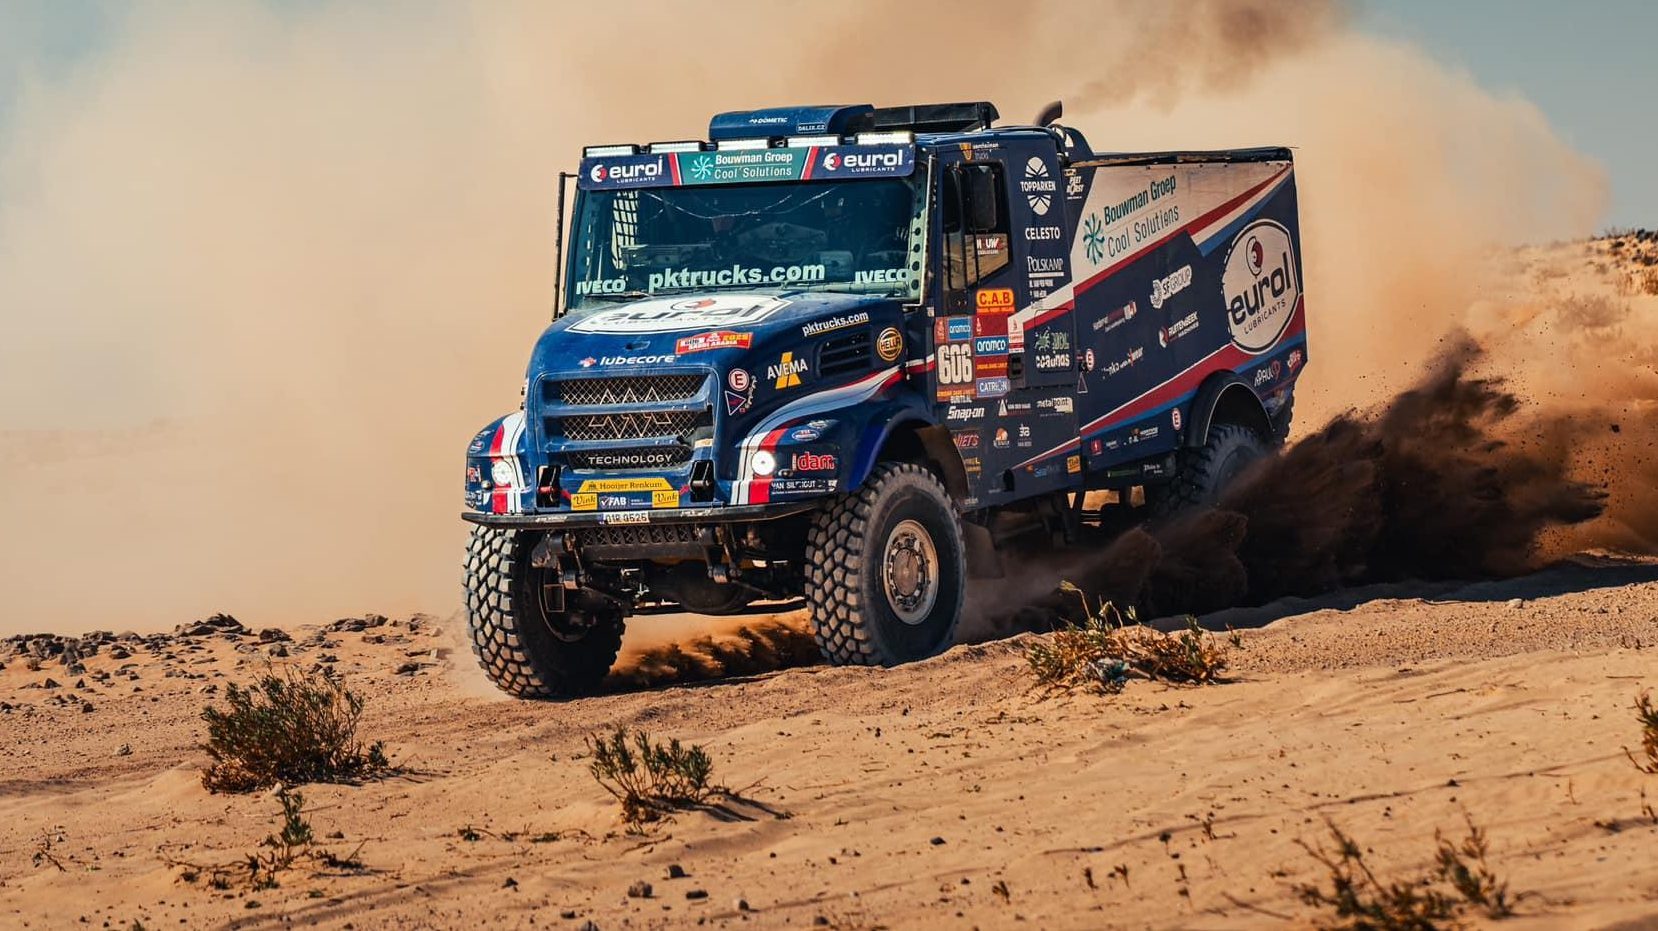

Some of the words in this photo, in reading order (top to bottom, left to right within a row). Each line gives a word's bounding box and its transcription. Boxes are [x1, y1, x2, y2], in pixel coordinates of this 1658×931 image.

[609, 155, 663, 178] eurol
[715, 153, 762, 165] Bouwman
[765, 152, 793, 164] Groep
[843, 149, 903, 168] eurol
[714, 168, 738, 179] Cool
[742, 166, 793, 178] Solutions
[1020, 180, 1056, 193] TOPPARKEN
[1103, 190, 1149, 226] Bouwman
[1150, 175, 1177, 202] Groep
[1025, 226, 1061, 240] CELESTO
[1107, 230, 1131, 258] Cool
[1135, 205, 1180, 242] Solutions
[649, 263, 826, 292] pktrucks.com
[854, 268, 910, 285] IVECO
[576, 279, 627, 295] IVECO
[1230, 251, 1291, 326] eurol
[802, 311, 869, 337] pktrucks.com
[1243, 299, 1287, 335] LUBRICANTS
[949, 325, 971, 333] aramco
[976, 339, 1007, 352] aramco
[600, 355, 675, 366] lubecore
[767, 358, 808, 380] AVEMA
[938, 343, 973, 384] 606
[947, 405, 985, 421] Snap-on
[588, 454, 673, 465] TECHNOLOGY
